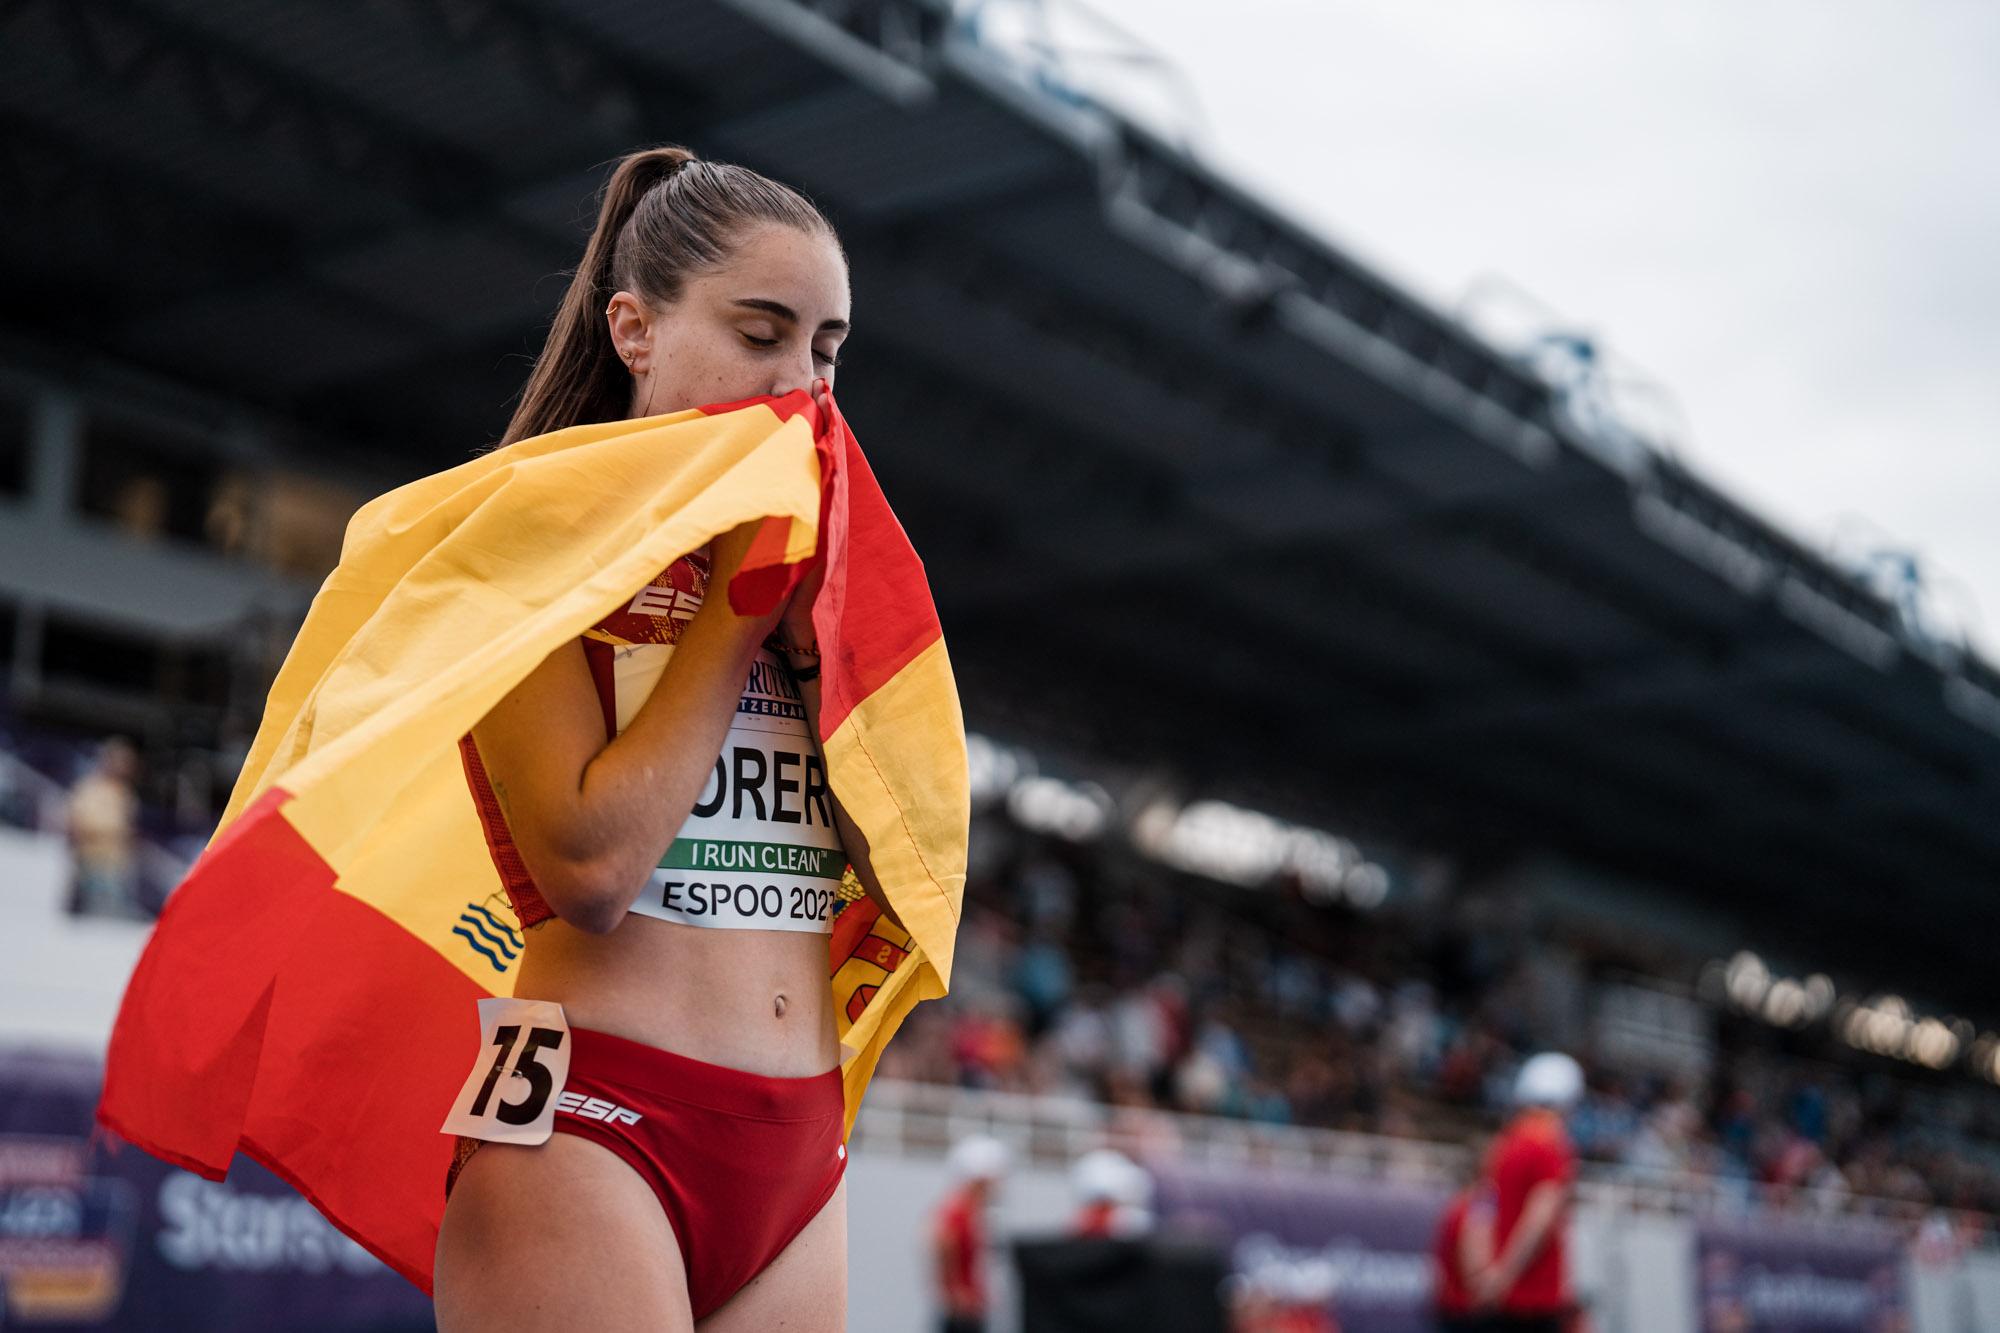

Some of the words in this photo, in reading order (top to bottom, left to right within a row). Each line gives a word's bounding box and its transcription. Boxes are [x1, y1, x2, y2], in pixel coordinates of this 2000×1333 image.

[692, 842, 698, 866] I
[703, 843, 756, 868] RUN
[662, 881, 783, 918] ESPOO
[469, 1024, 565, 1126] 15
[554, 1090, 643, 1126] ESP
